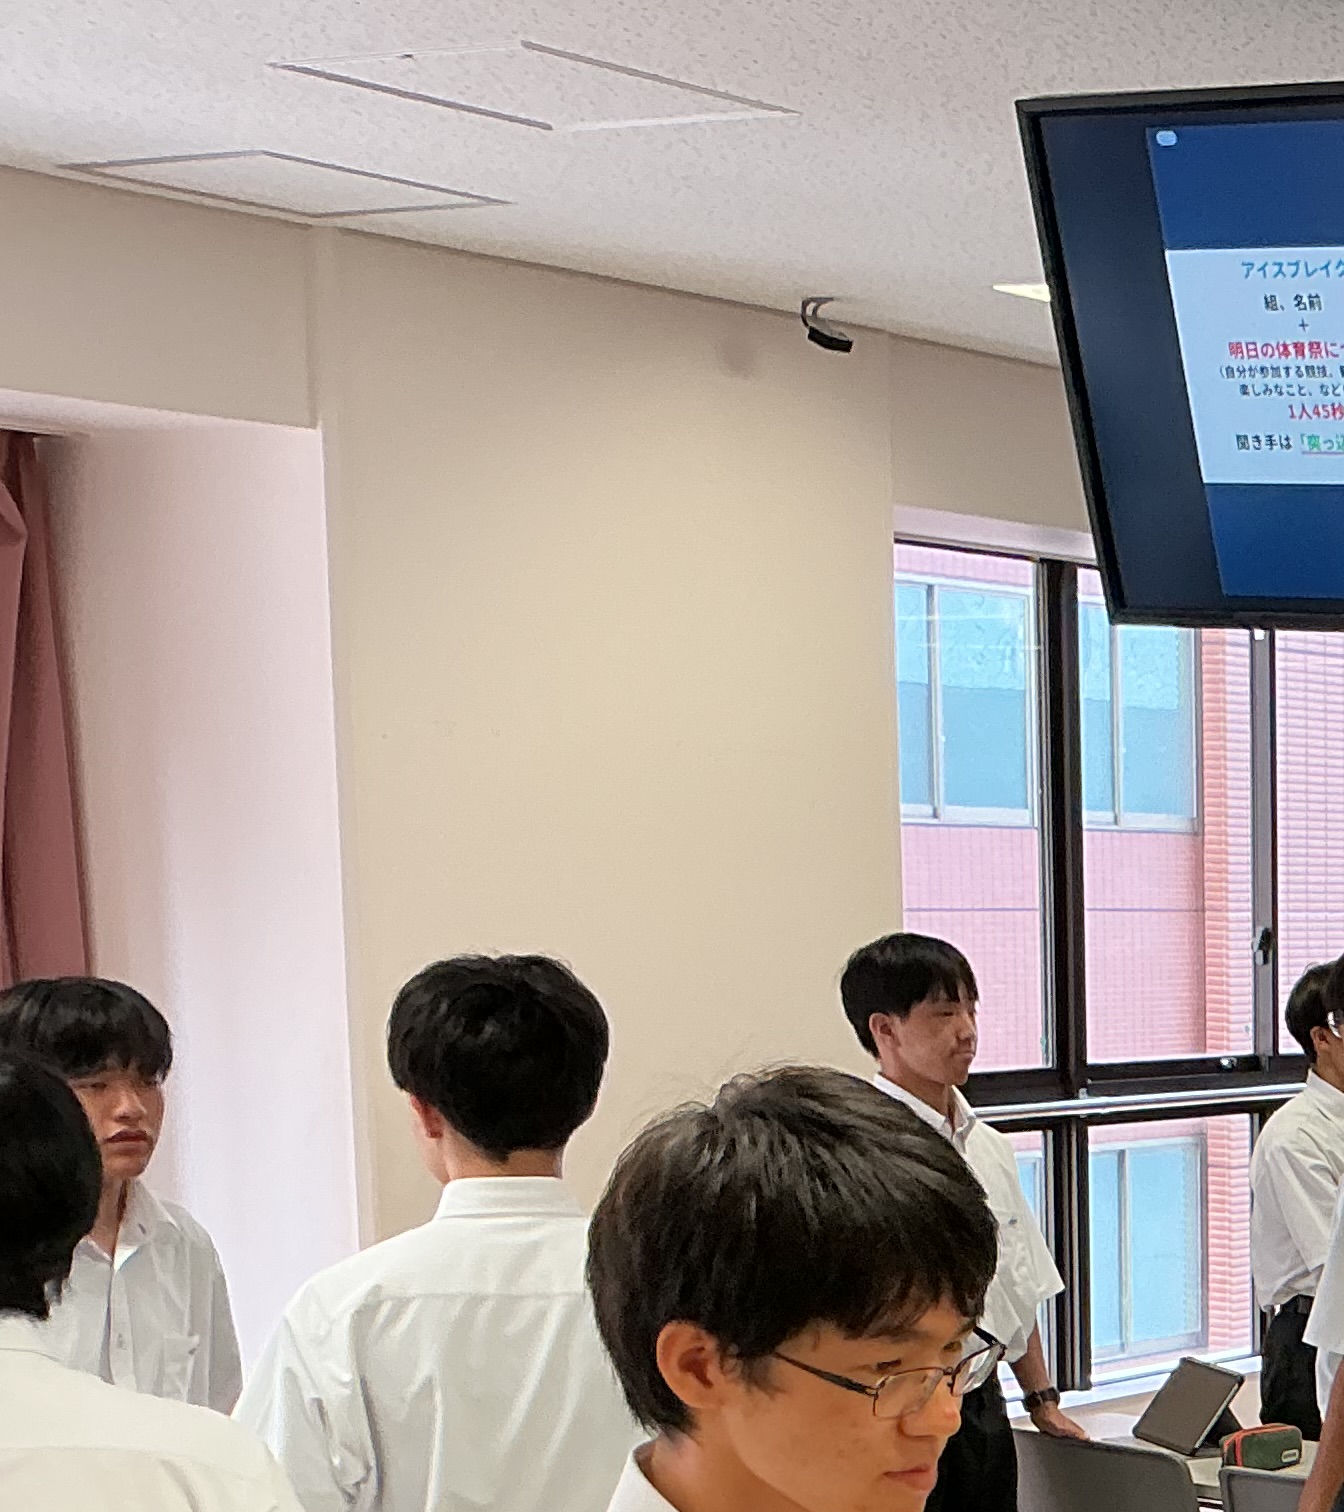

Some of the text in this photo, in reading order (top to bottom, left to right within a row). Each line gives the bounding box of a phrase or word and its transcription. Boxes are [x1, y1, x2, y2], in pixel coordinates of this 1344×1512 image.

[1263, 293, 1324, 312] 組、名前
[1235, 433, 1294, 452] 聞き手は
